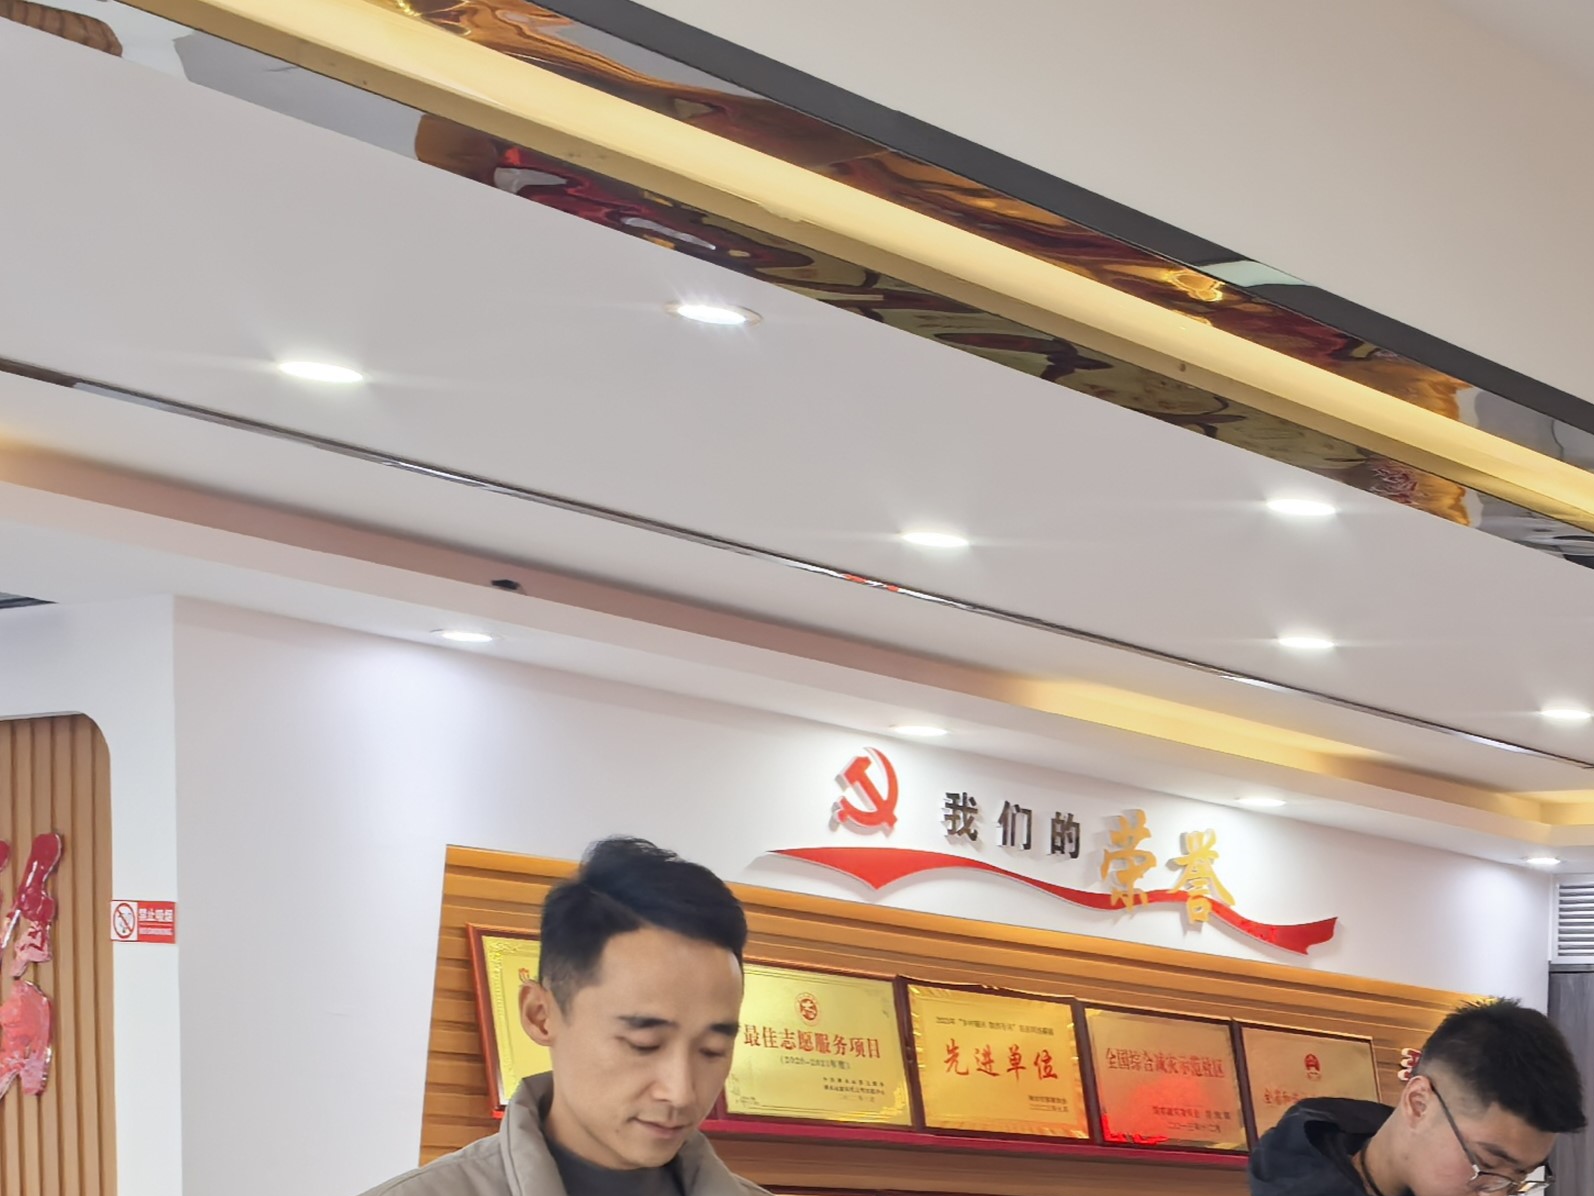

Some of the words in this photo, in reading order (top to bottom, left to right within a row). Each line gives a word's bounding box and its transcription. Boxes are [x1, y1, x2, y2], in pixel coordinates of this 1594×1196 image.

[744, 1024, 881, 1059] 最佳志愿服务项目
[944, 1038, 1058, 1084] 先进单位
